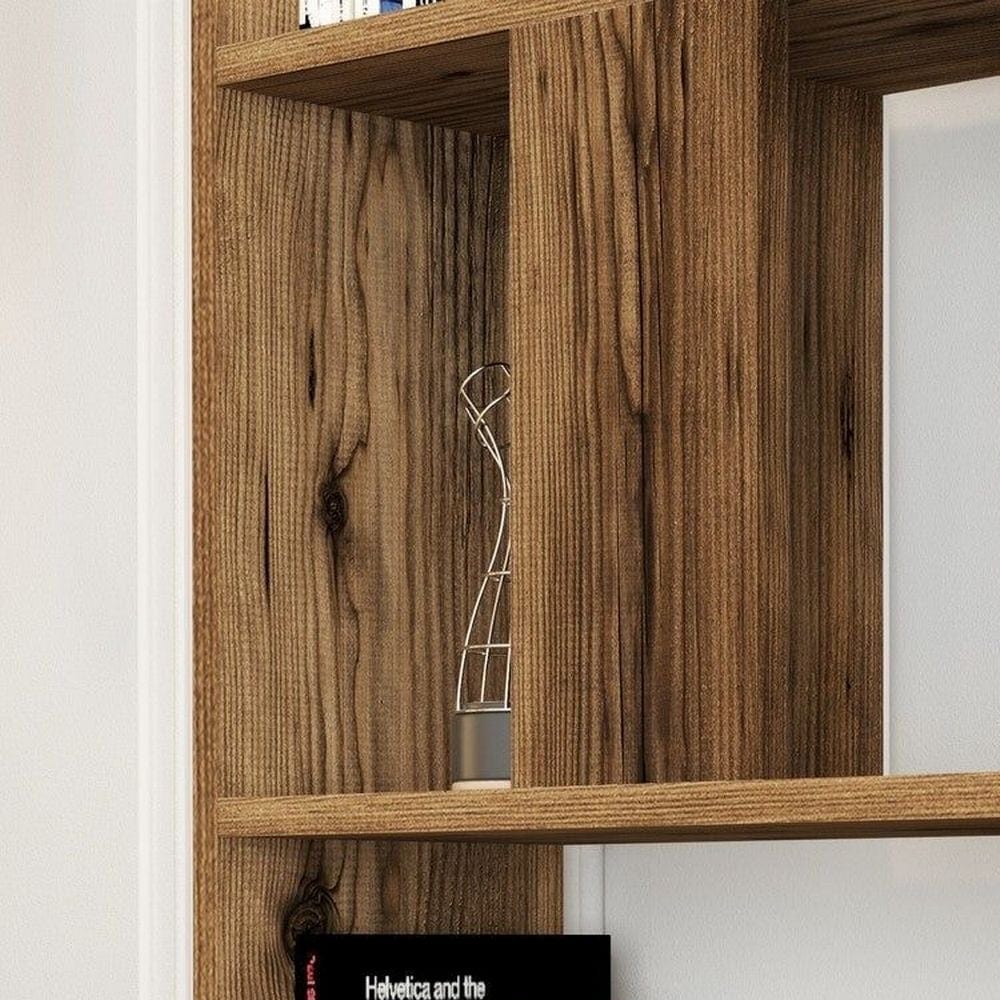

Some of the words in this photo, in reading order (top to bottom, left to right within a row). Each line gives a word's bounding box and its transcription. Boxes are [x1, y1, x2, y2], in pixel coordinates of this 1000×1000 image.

[365, 975, 431, 1000] Helvetica
[433, 975, 460, 1000] and
[463, 975, 486, 1000] the
